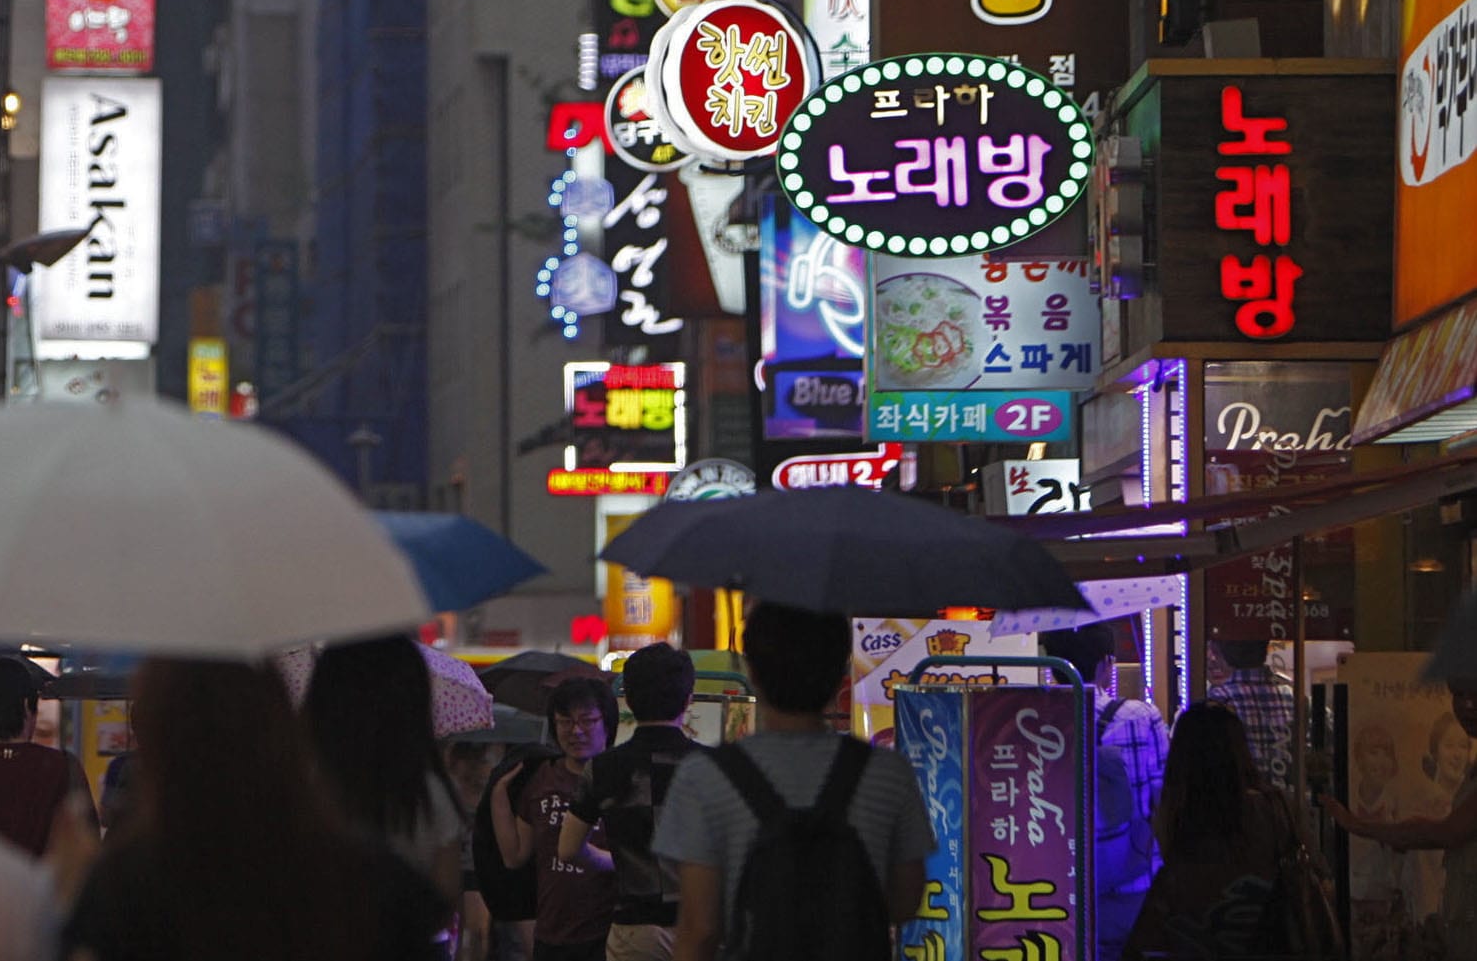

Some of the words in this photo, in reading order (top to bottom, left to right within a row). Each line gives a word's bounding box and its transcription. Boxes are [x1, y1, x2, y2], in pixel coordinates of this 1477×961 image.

[706, 88, 778, 140] 치킨
[870, 83, 995, 126] 프라하
[825, 134, 1053, 208] 노래방
[85, 92, 128, 300] Asakan
[1214, 85, 1304, 339] 노래방
[982, 294, 1072, 332] 볶음
[983, 343, 1093, 374] 스파게
[876, 404, 988, 432] 좌식카페
[1005, 404, 1052, 432] 2F
[860, 632, 902, 653] Cass
[1015, 707, 1066, 848] Praha
